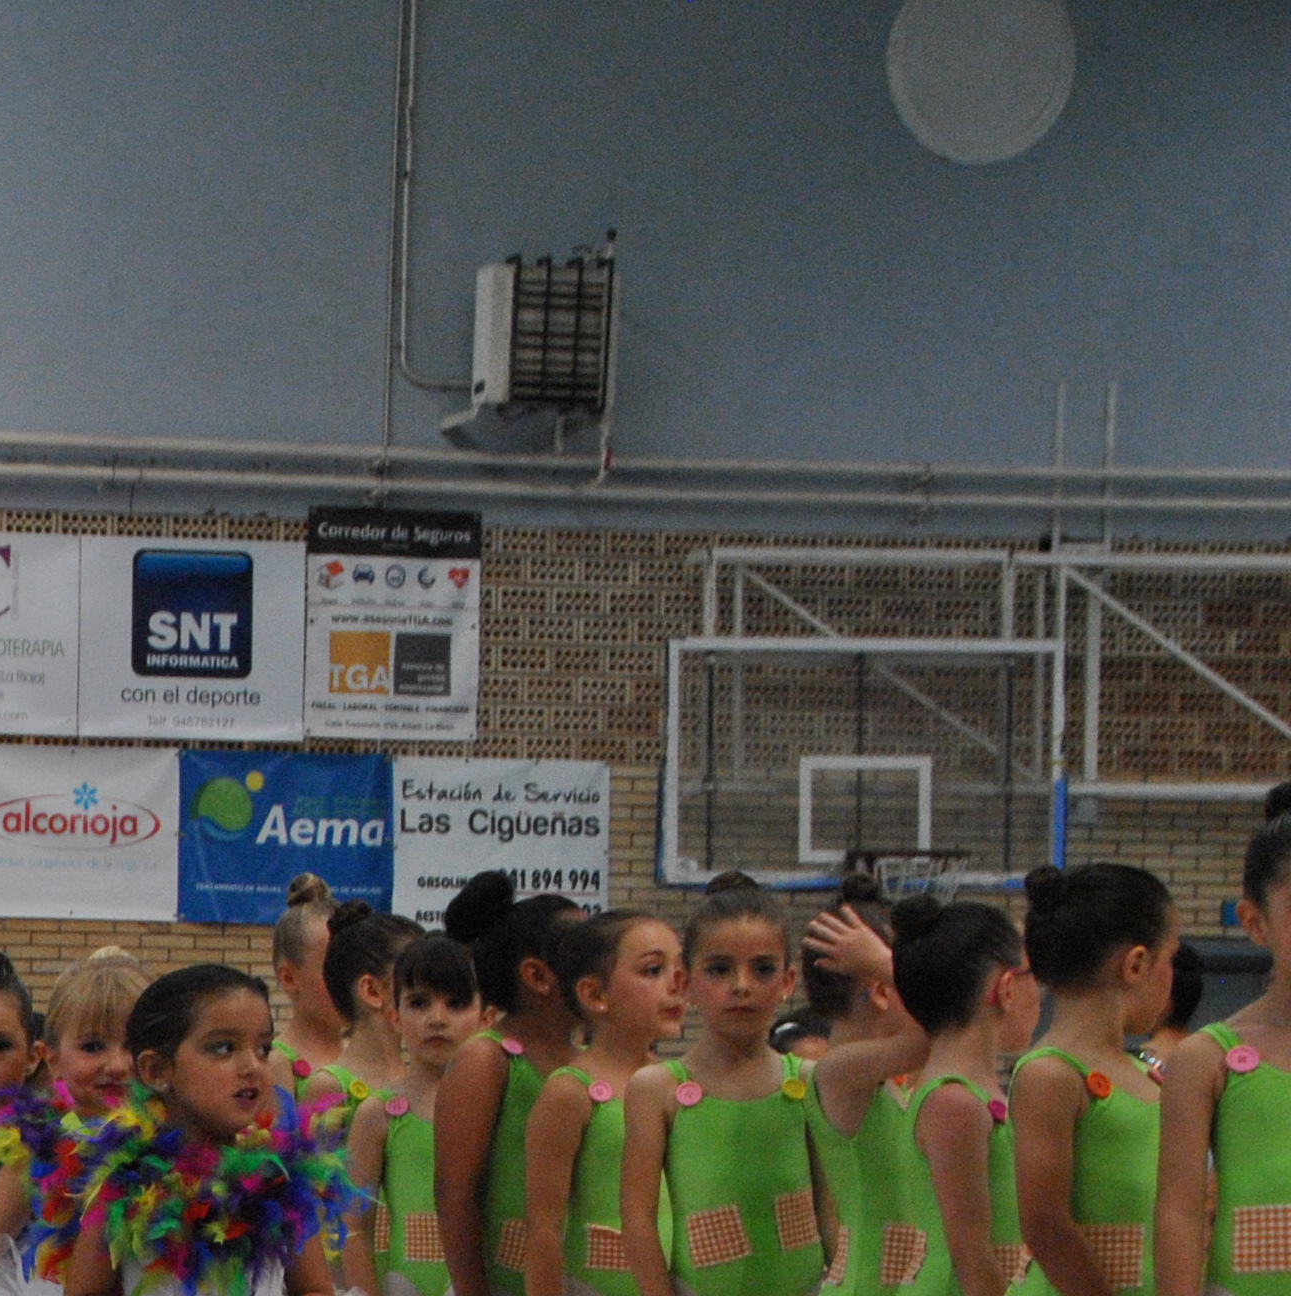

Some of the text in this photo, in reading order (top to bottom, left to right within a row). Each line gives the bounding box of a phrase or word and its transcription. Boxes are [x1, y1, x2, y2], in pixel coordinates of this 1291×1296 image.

[319, 521, 472, 545] Corredor de Seguros
[147, 610, 238, 652] SNT
[146, 653, 239, 669] INFORMATICA
[330, 663, 390, 692] TGA
[121, 686, 261, 709] con el deporte
[402, 778, 601, 804] Estación de Servicio
[2, 799, 139, 845] alcorioja
[255, 804, 386, 848] Aema
[400, 808, 600, 843] Las Cigüeñas
[417, 874, 473, 890] GASOLIN
[530, 868, 563, 891] 894
[567, 869, 602, 891] 994
